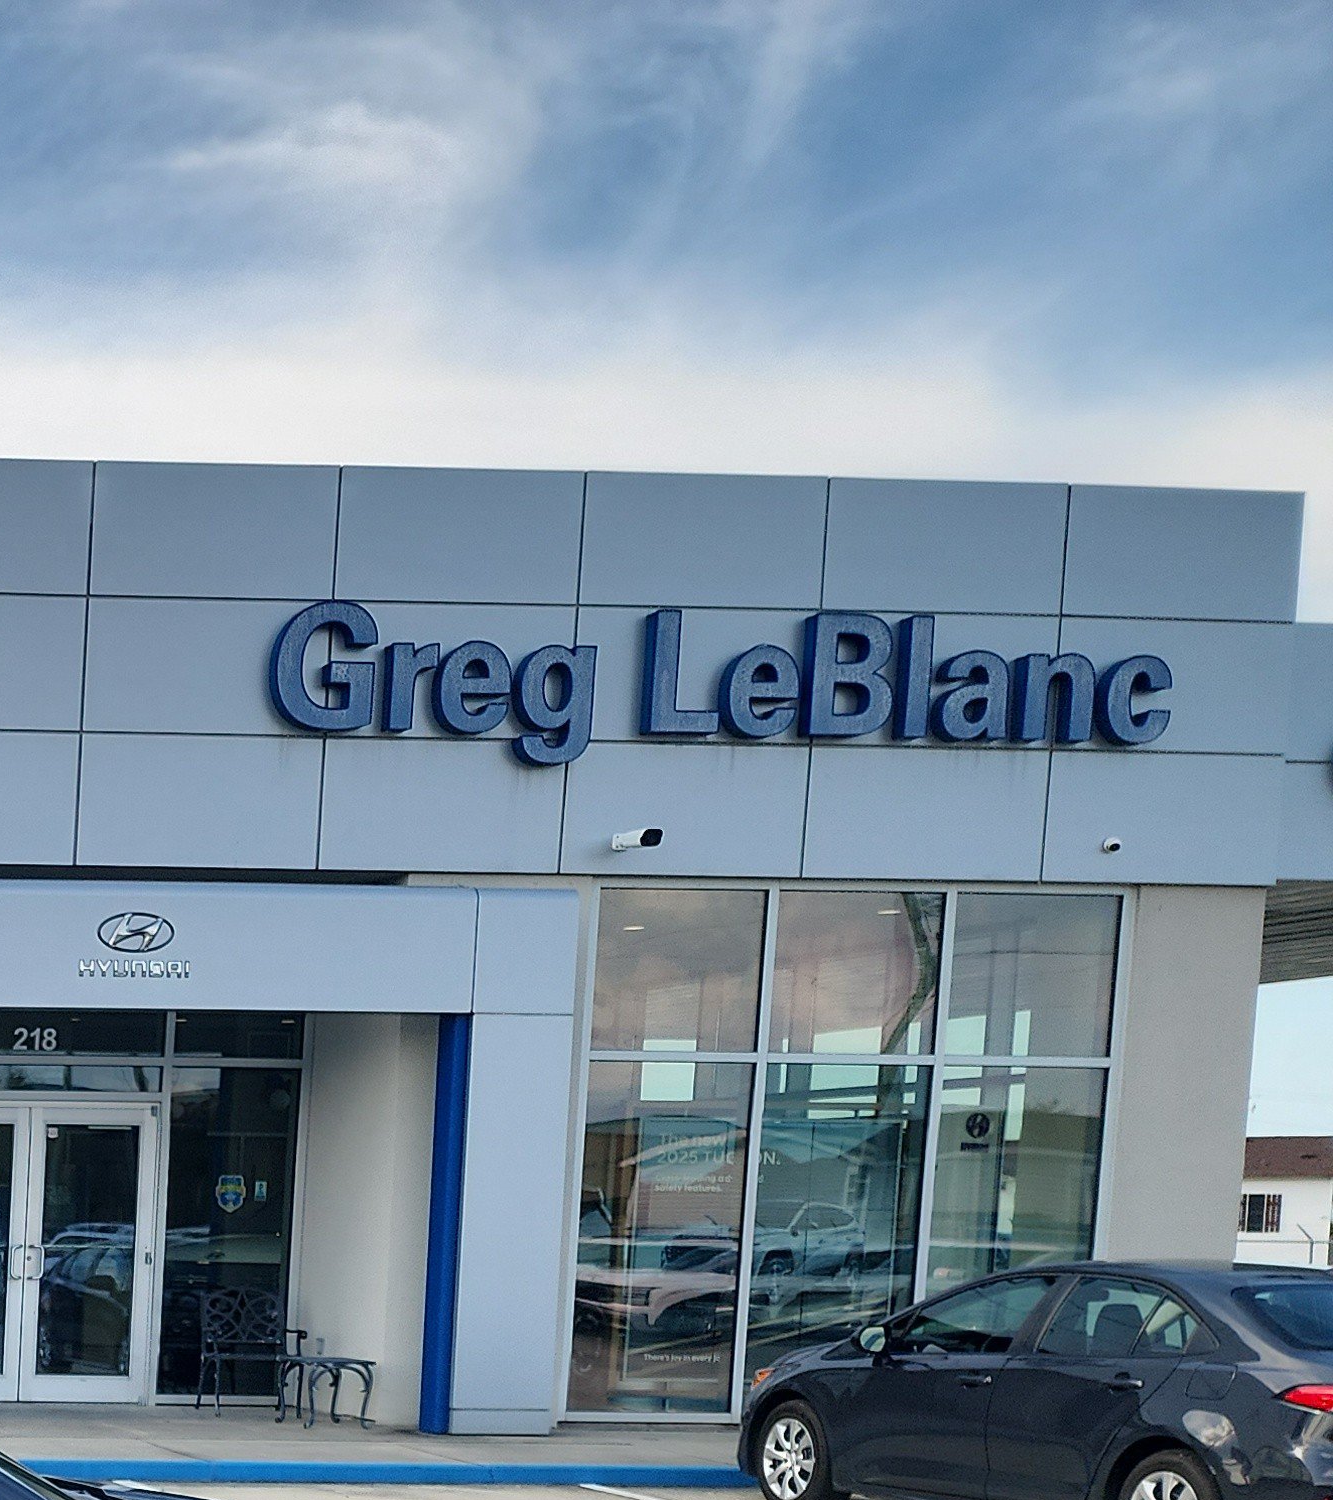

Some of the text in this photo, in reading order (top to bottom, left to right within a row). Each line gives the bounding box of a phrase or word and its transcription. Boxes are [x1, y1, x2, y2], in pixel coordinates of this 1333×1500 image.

[269, 602, 1173, 766] Greg LeBlanc
[78, 959, 190, 979] HYUNDAI
[13, 1027, 57, 1051] 218
[657, 1151, 698, 1164] 2025
